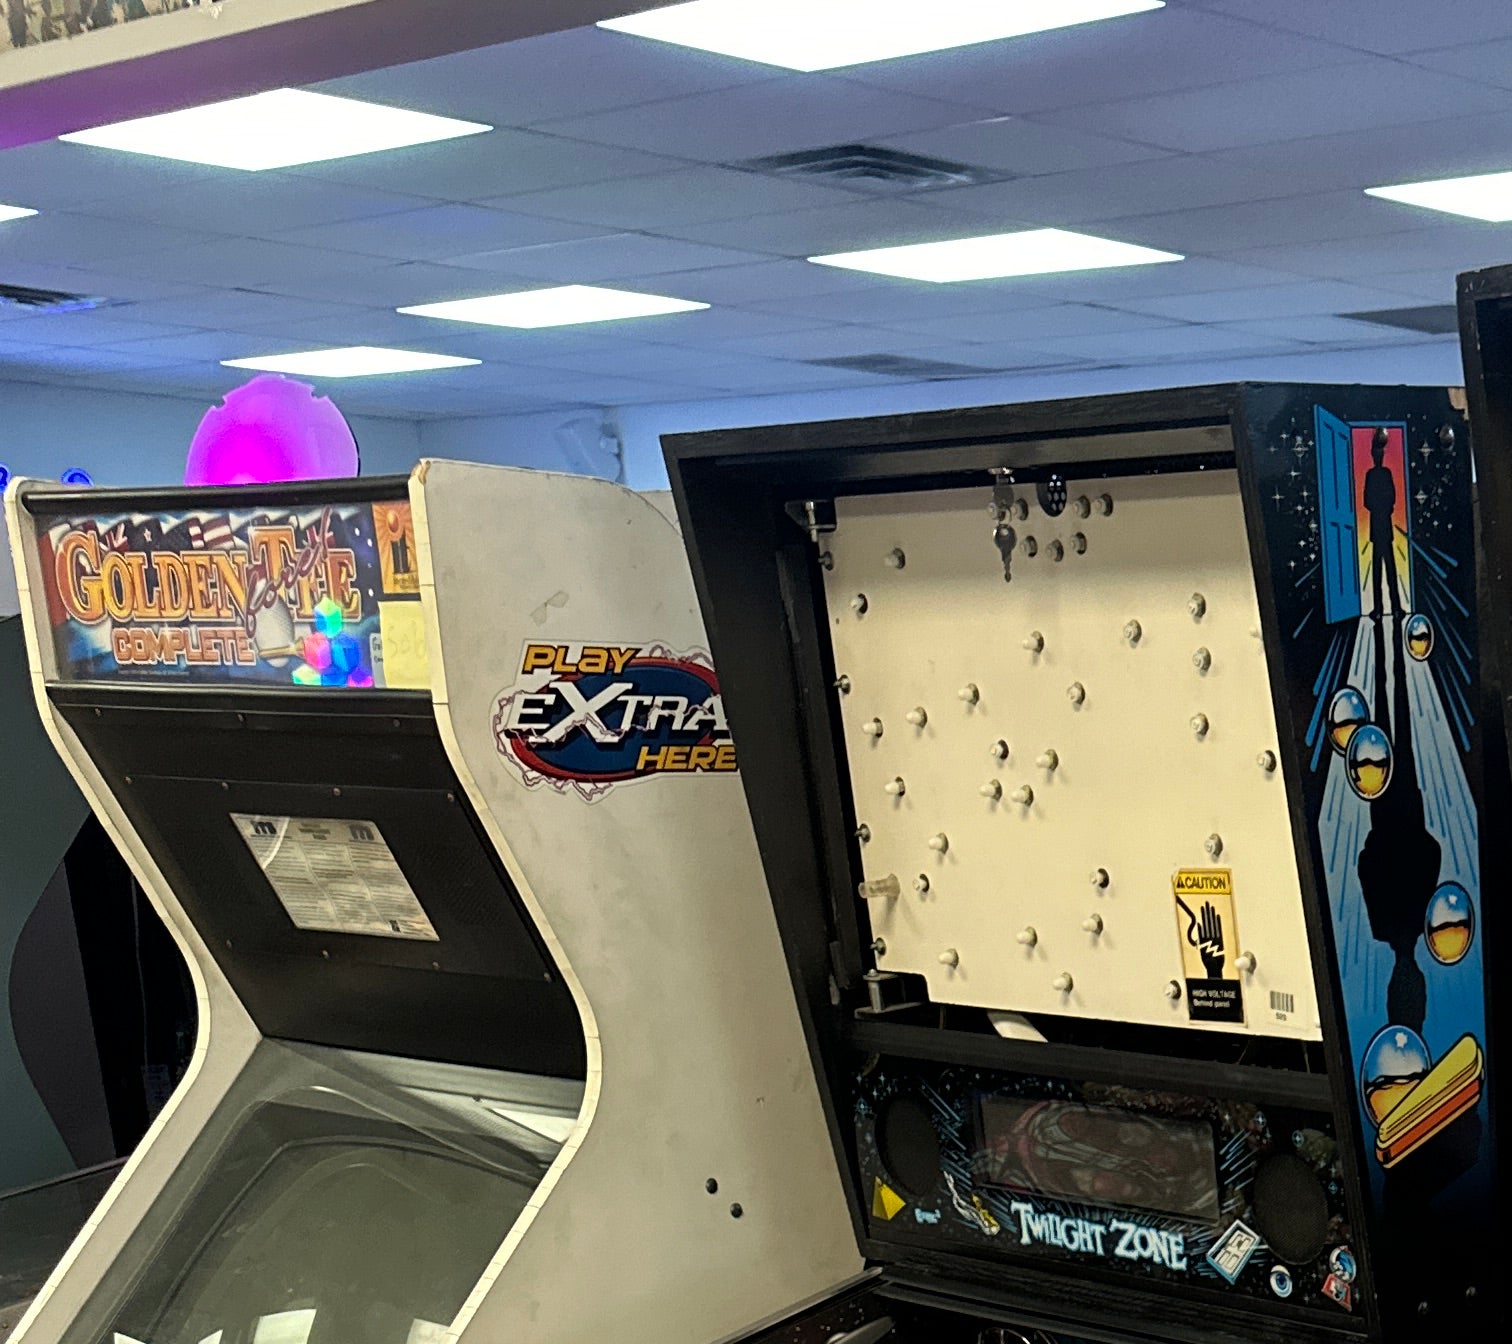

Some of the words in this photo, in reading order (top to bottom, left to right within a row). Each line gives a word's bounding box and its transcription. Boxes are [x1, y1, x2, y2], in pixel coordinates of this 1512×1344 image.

[55, 530, 247, 624] GOLDEN
[112, 625, 258, 666] COMPLETE
[506, 681, 730, 743] EXTRA
[635, 745, 737, 772] HERE
[1185, 876, 1226, 889] CAUTION
[1011, 1202, 1107, 1257] TWILIGHT
[1108, 1218, 1188, 1271] ZONE
